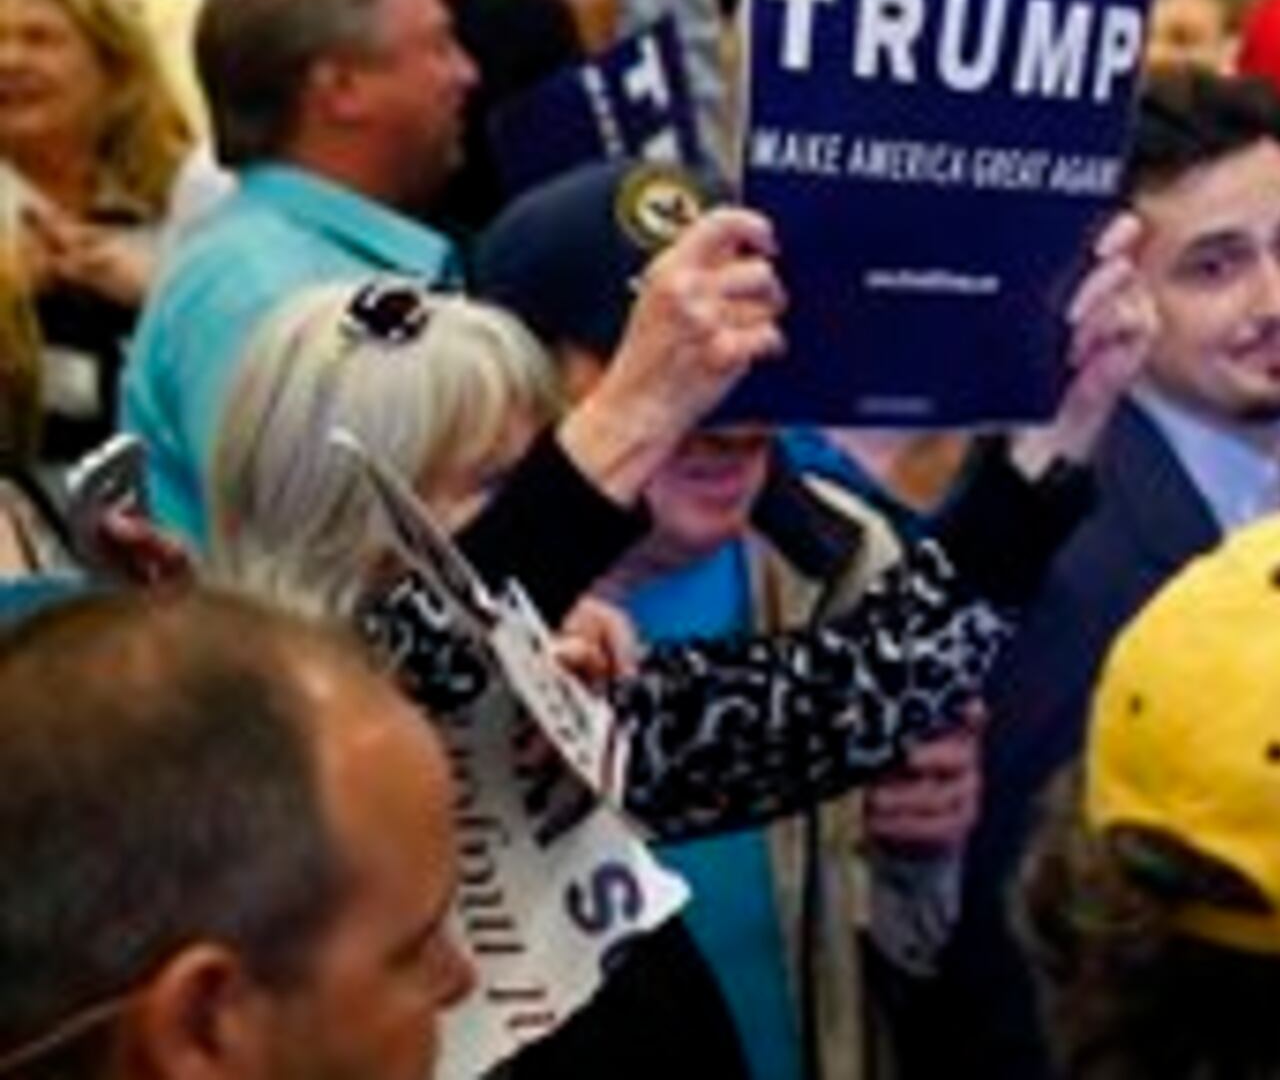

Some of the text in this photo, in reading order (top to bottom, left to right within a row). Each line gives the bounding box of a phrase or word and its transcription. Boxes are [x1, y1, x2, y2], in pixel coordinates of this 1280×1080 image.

[751, 126, 842, 175] MAKE
[848, 137, 966, 183] AMERICA
[972, 146, 1049, 190] GREAT
